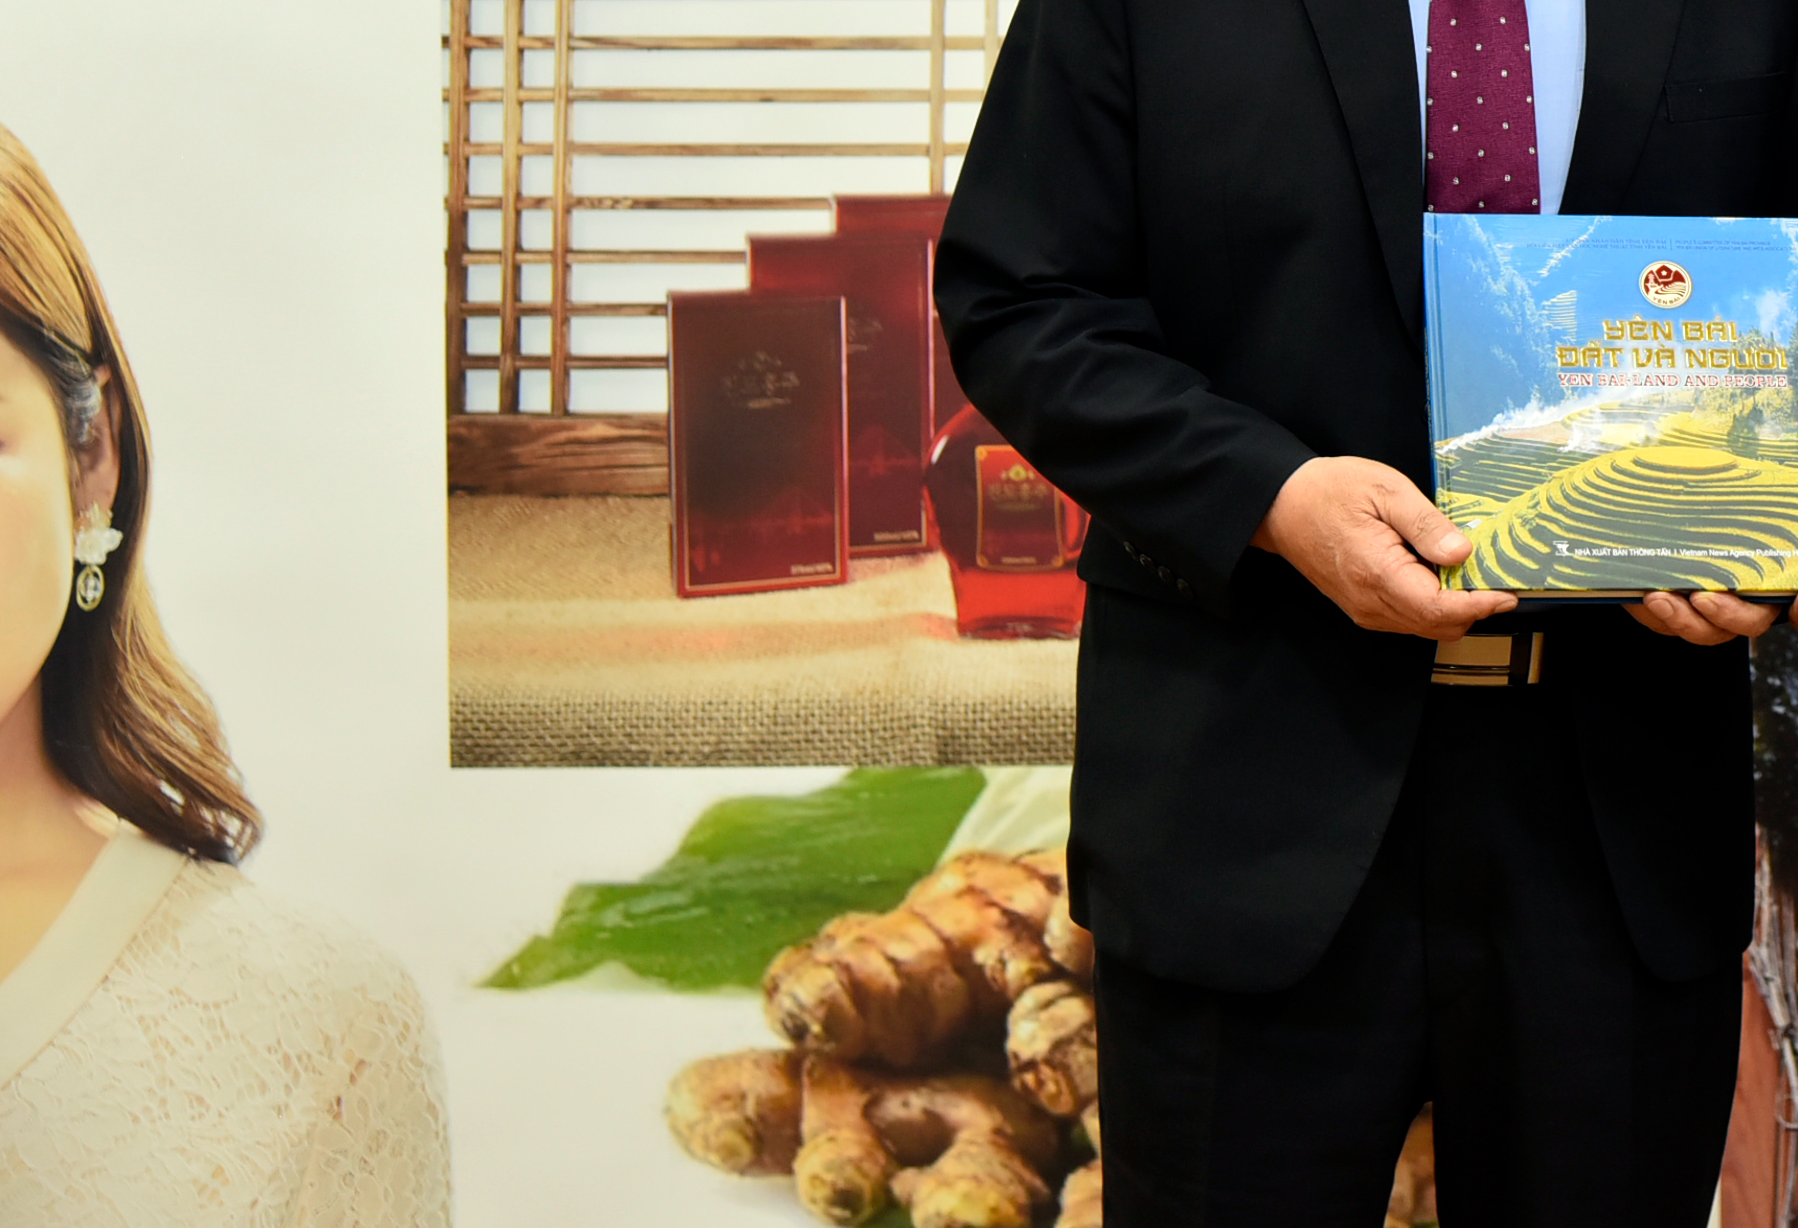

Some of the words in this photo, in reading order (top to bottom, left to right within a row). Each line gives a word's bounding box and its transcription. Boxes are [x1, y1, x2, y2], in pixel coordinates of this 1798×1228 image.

[1603, 313, 1674, 342] YÊN
[1682, 313, 1739, 343] BÁI
[1556, 341, 1624, 369] ĐẤT
[1632, 341, 1677, 369] VÀ
[1557, 373, 1594, 388] YEN
[1684, 374, 1720, 389] AND
[1722, 374, 1788, 389] PEOPLE
[1679, 548, 1708, 557] Vietnam
[1709, 548, 1729, 557] News
[1729, 548, 1755, 558] Agency
[1756, 548, 1792, 558] Publishing
